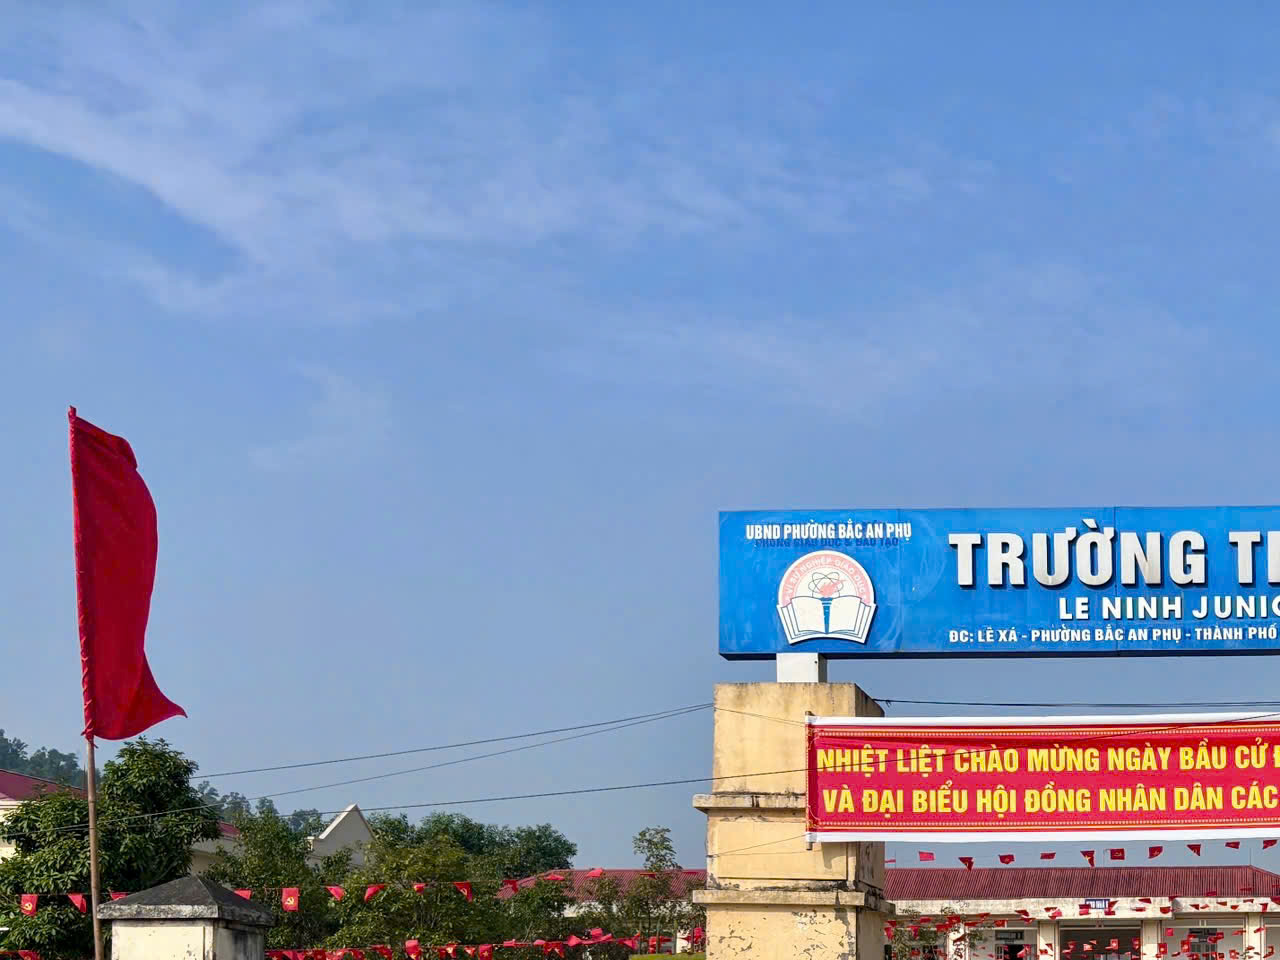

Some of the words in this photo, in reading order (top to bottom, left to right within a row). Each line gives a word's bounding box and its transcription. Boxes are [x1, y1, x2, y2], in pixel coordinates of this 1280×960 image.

[746, 524, 781, 540] UBND
[784, 519, 835, 540] PHƯỜNG
[838, 518, 863, 540] BẮC
[865, 523, 883, 539] AN
[886, 522, 912, 541] PHỤ
[948, 518, 1208, 587] TRƯỜNG
[1059, 596, 1089, 620] LE
[1102, 596, 1182, 620] NINH
[949, 629, 974, 643] ĐC:
[978, 626, 995, 642] LÊ
[998, 626, 1017, 642] XÁ
[1031, 623, 1091, 642] PHƯỜNG
[1094, 624, 1124, 641] BẮC
[1127, 628, 1149, 641] AN
[1152, 627, 1182, 644] PHỤ
[1195, 624, 1243, 641] THÀNH
[1248, 622, 1277, 639] PHỐ
[816, 744, 889, 778] NHIỆT
[896, 744, 948, 777] LIỆT
[953, 743, 1019, 774] CHÀO
[1027, 742, 1100, 773] MỪNG
[1107, 742, 1172, 772] NGÀY
[1179, 737, 1227, 771] BẦU
[1234, 736, 1269, 769] CỬ
[822, 783, 855, 814] VÀ
[862, 788, 904, 819] ĐẠI
[912, 780, 968, 814] BIỂU
[976, 784, 1017, 818] HỘI
[1023, 781, 1091, 814] ĐỒNG
[1099, 782, 1166, 812] NHÂN
[1174, 782, 1224, 811] DÂN
[1231, 778, 1278, 808] CÁC
